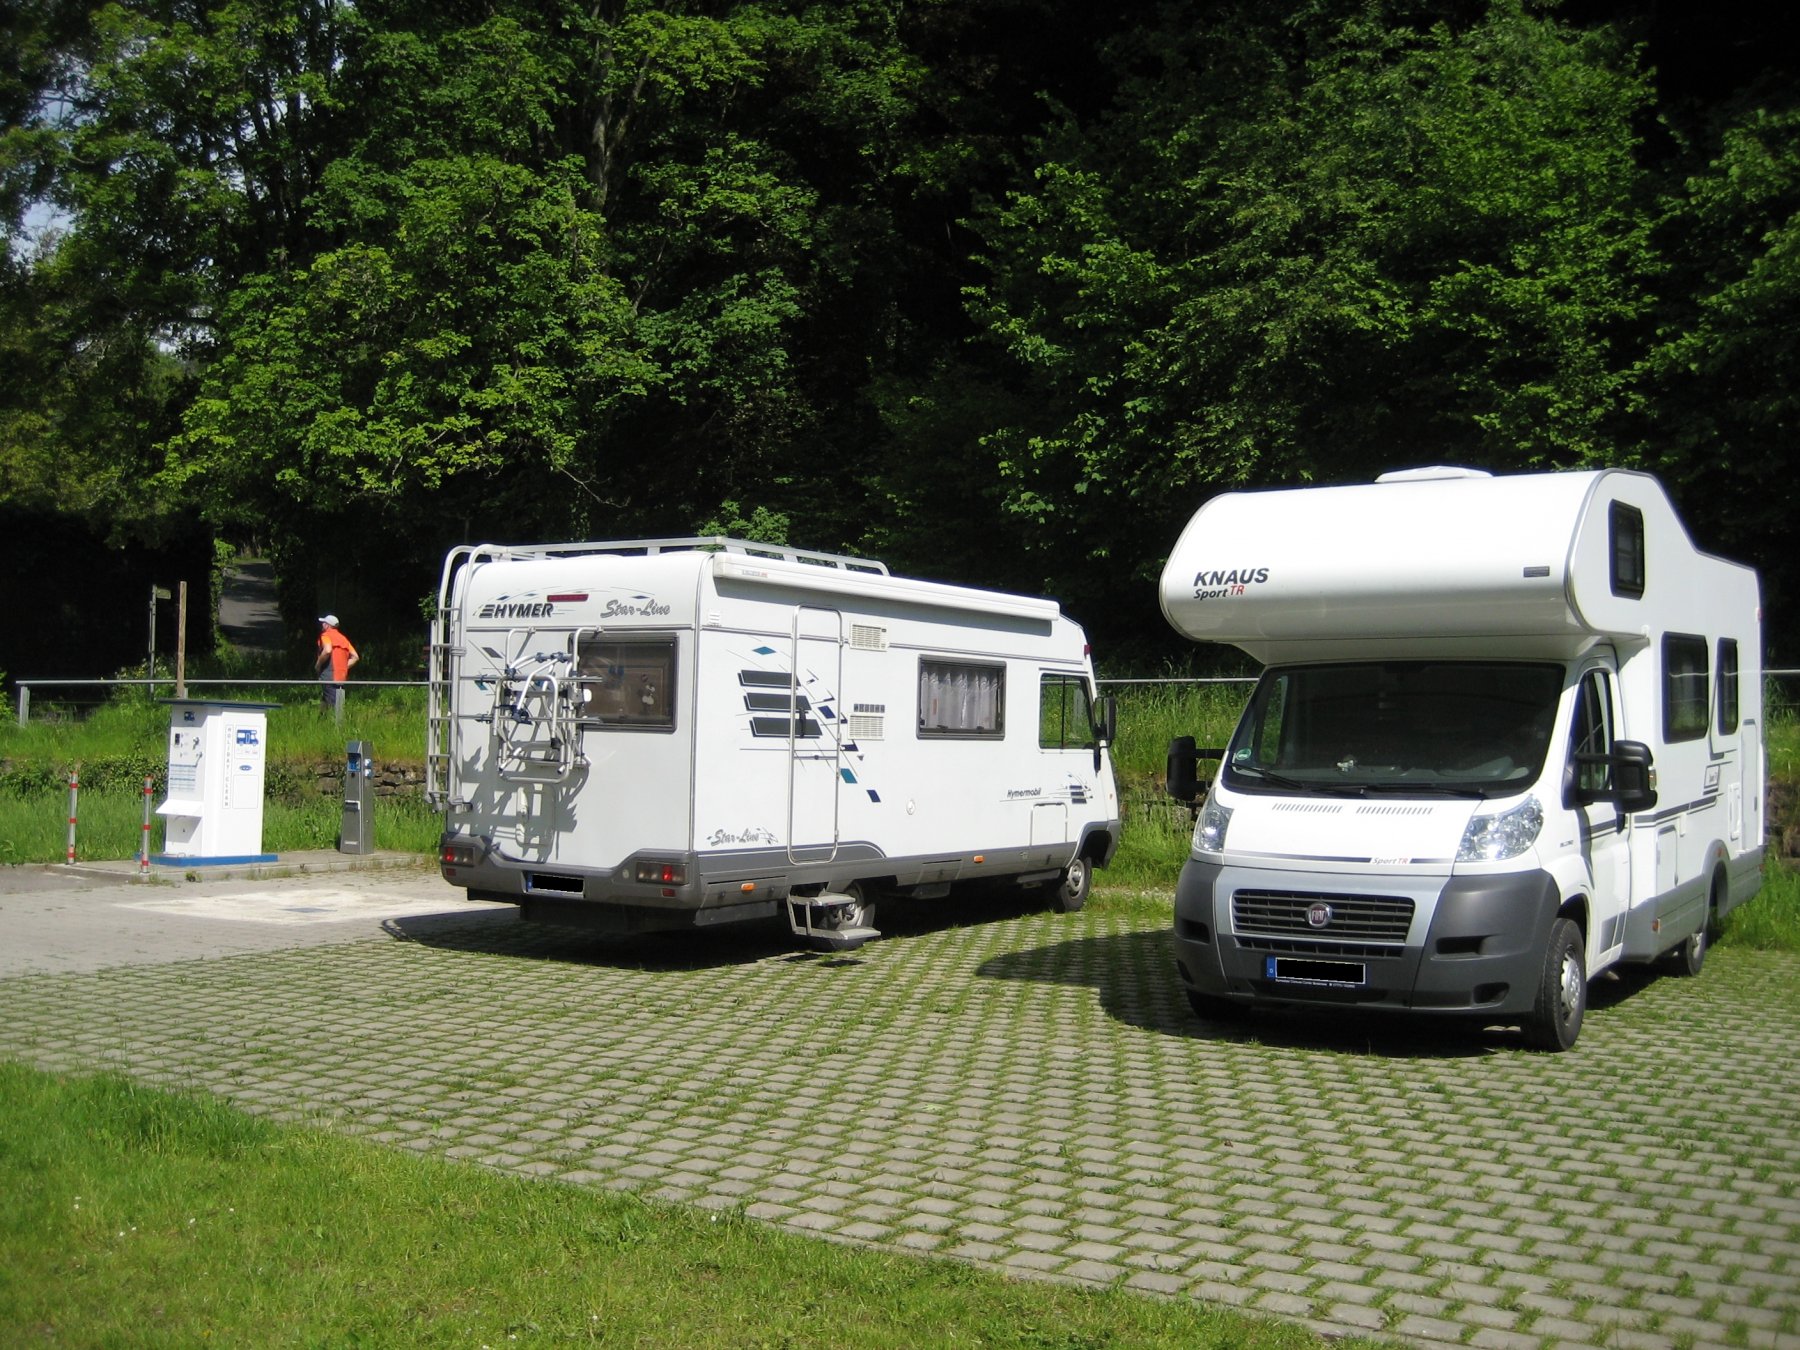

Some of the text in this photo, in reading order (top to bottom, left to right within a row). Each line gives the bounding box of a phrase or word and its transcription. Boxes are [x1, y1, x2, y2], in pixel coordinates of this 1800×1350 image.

[1194, 568, 1269, 586] KNAUS
[1194, 585, 1245, 600] Sport TR
[600, 599, 671, 619] Star-Line
[1006, 787, 1042, 799] Hymermobil
[1372, 857, 1397, 865] Sport
